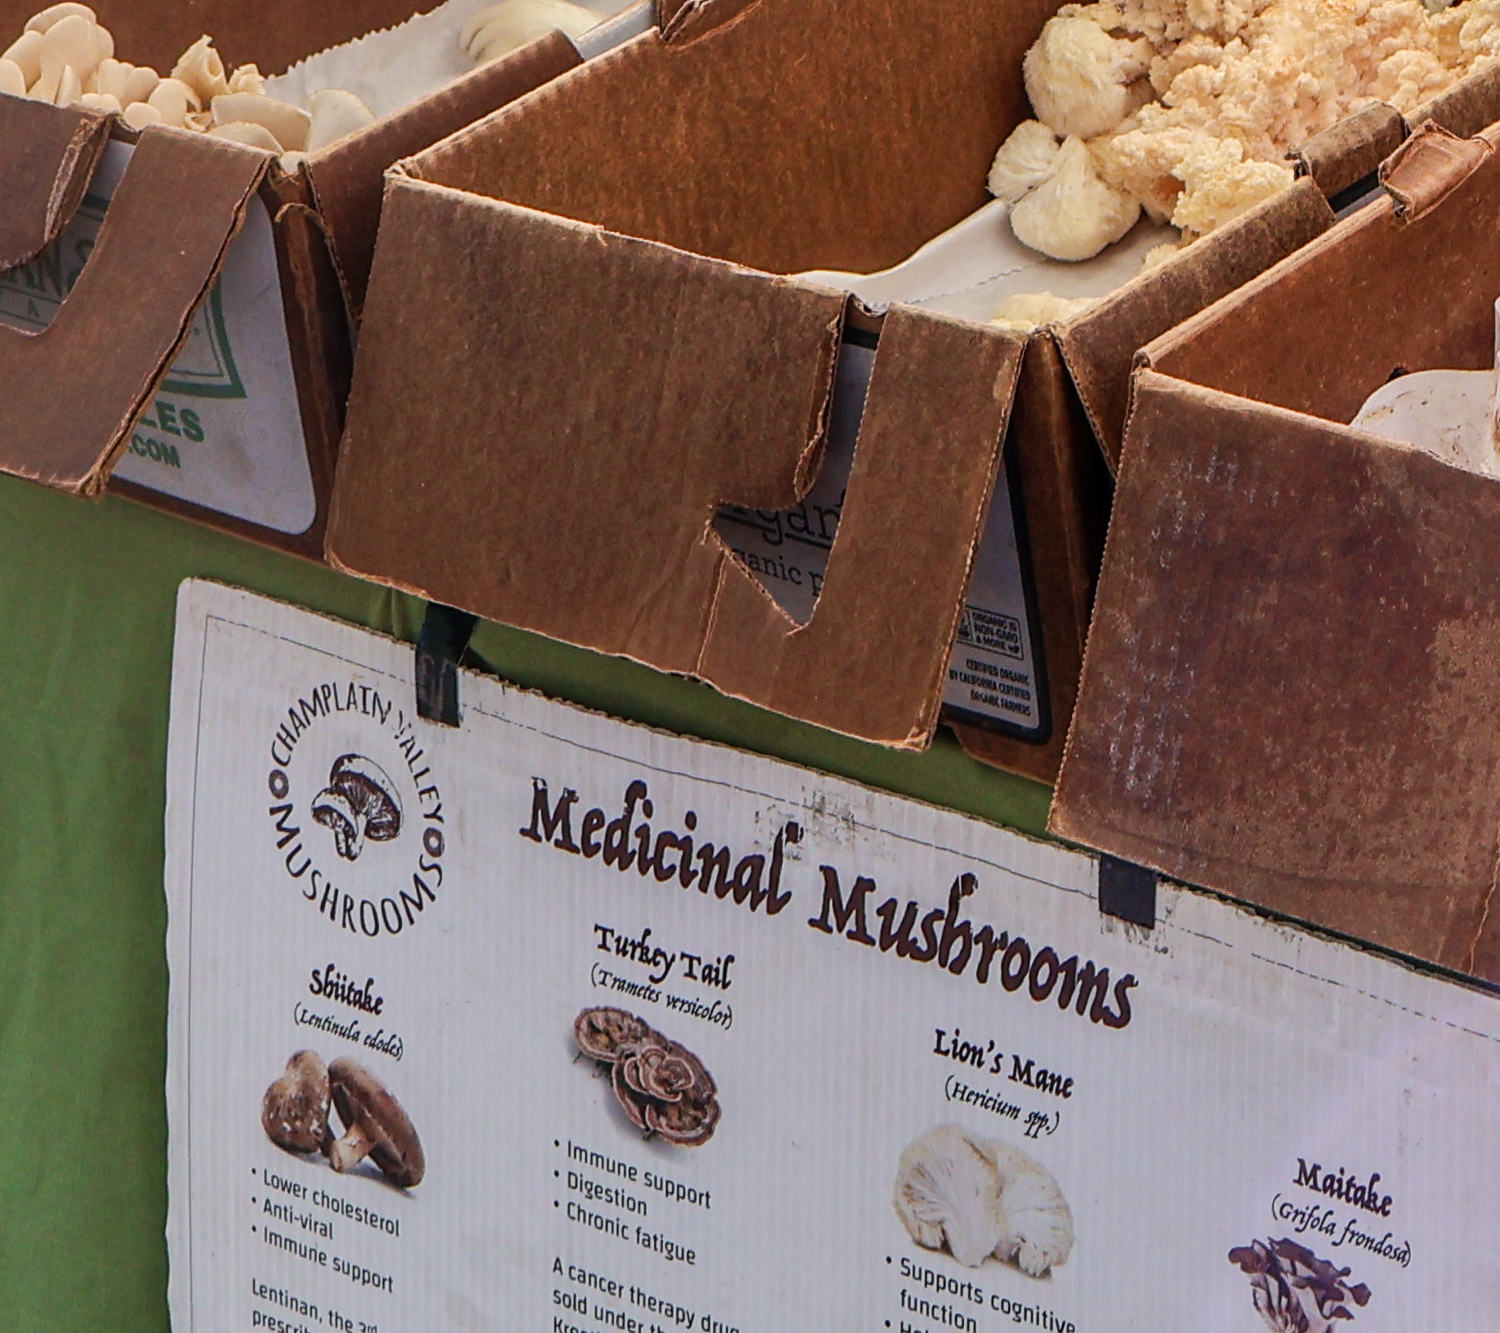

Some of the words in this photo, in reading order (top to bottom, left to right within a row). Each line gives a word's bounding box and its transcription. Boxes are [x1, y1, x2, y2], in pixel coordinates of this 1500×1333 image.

[960, 673, 997, 691] CALIFORNIA
[966, 659, 999, 676] CERTIFIED
[270, 681, 392, 768] CHAMPLAIN
[268, 808, 444, 936] MUSHROOMS
[518, 778, 805, 916] Medicinal
[807, 864, 1138, 1028] Mushrooms
[309, 966, 385, 1015] Shiitake
[593, 924, 677, 985] Turkey
[679, 950, 735, 993] Tail
[590, 961, 663, 1007] (Trametes
[664, 986, 733, 1031] versicolor)
[293, 1003, 360, 1045] (Lentinula
[362, 1025, 405, 1061] edodes)
[933, 1028, 1004, 1077] Lion's
[1008, 1053, 1075, 1100] Mane
[944, 1073, 1020, 1121] (Hericium
[1023, 1108, 1060, 1140] spp.)
[263, 1168, 308, 1199] Lower
[313, 1185, 400, 1238] cholesterol
[567, 1139, 638, 1186] Immune
[643, 1169, 712, 1211] support
[567, 1169, 648, 1218] Digestion
[1292, 1158, 1394, 1218] Maitake
[263, 1197, 333, 1240] Anti-viral
[567, 1200, 629, 1246] Chronic
[634, 1223, 696, 1268] fatigue
[1270, 1192, 1338, 1237] (Grifola
[1340, 1217, 1413, 1269] frondosa)
[264, 1225, 327, 1268] Immune
[332, 1252, 394, 1295] support
[552, 1256, 564, 1276] A
[567, 1265, 624, 1299] cancer
[629, 1282, 695, 1331] therapy
[252, 1276, 323, 1323] Lentinan,
[328, 1305, 353, 1333] the
[552, 1286, 588, 1317] sold
[593, 1302, 643, 1333] under
[900, 1257, 984, 1304] Supports
[990, 1292, 1076, 1333] cognitive
[900, 1289, 977, 1333] function
